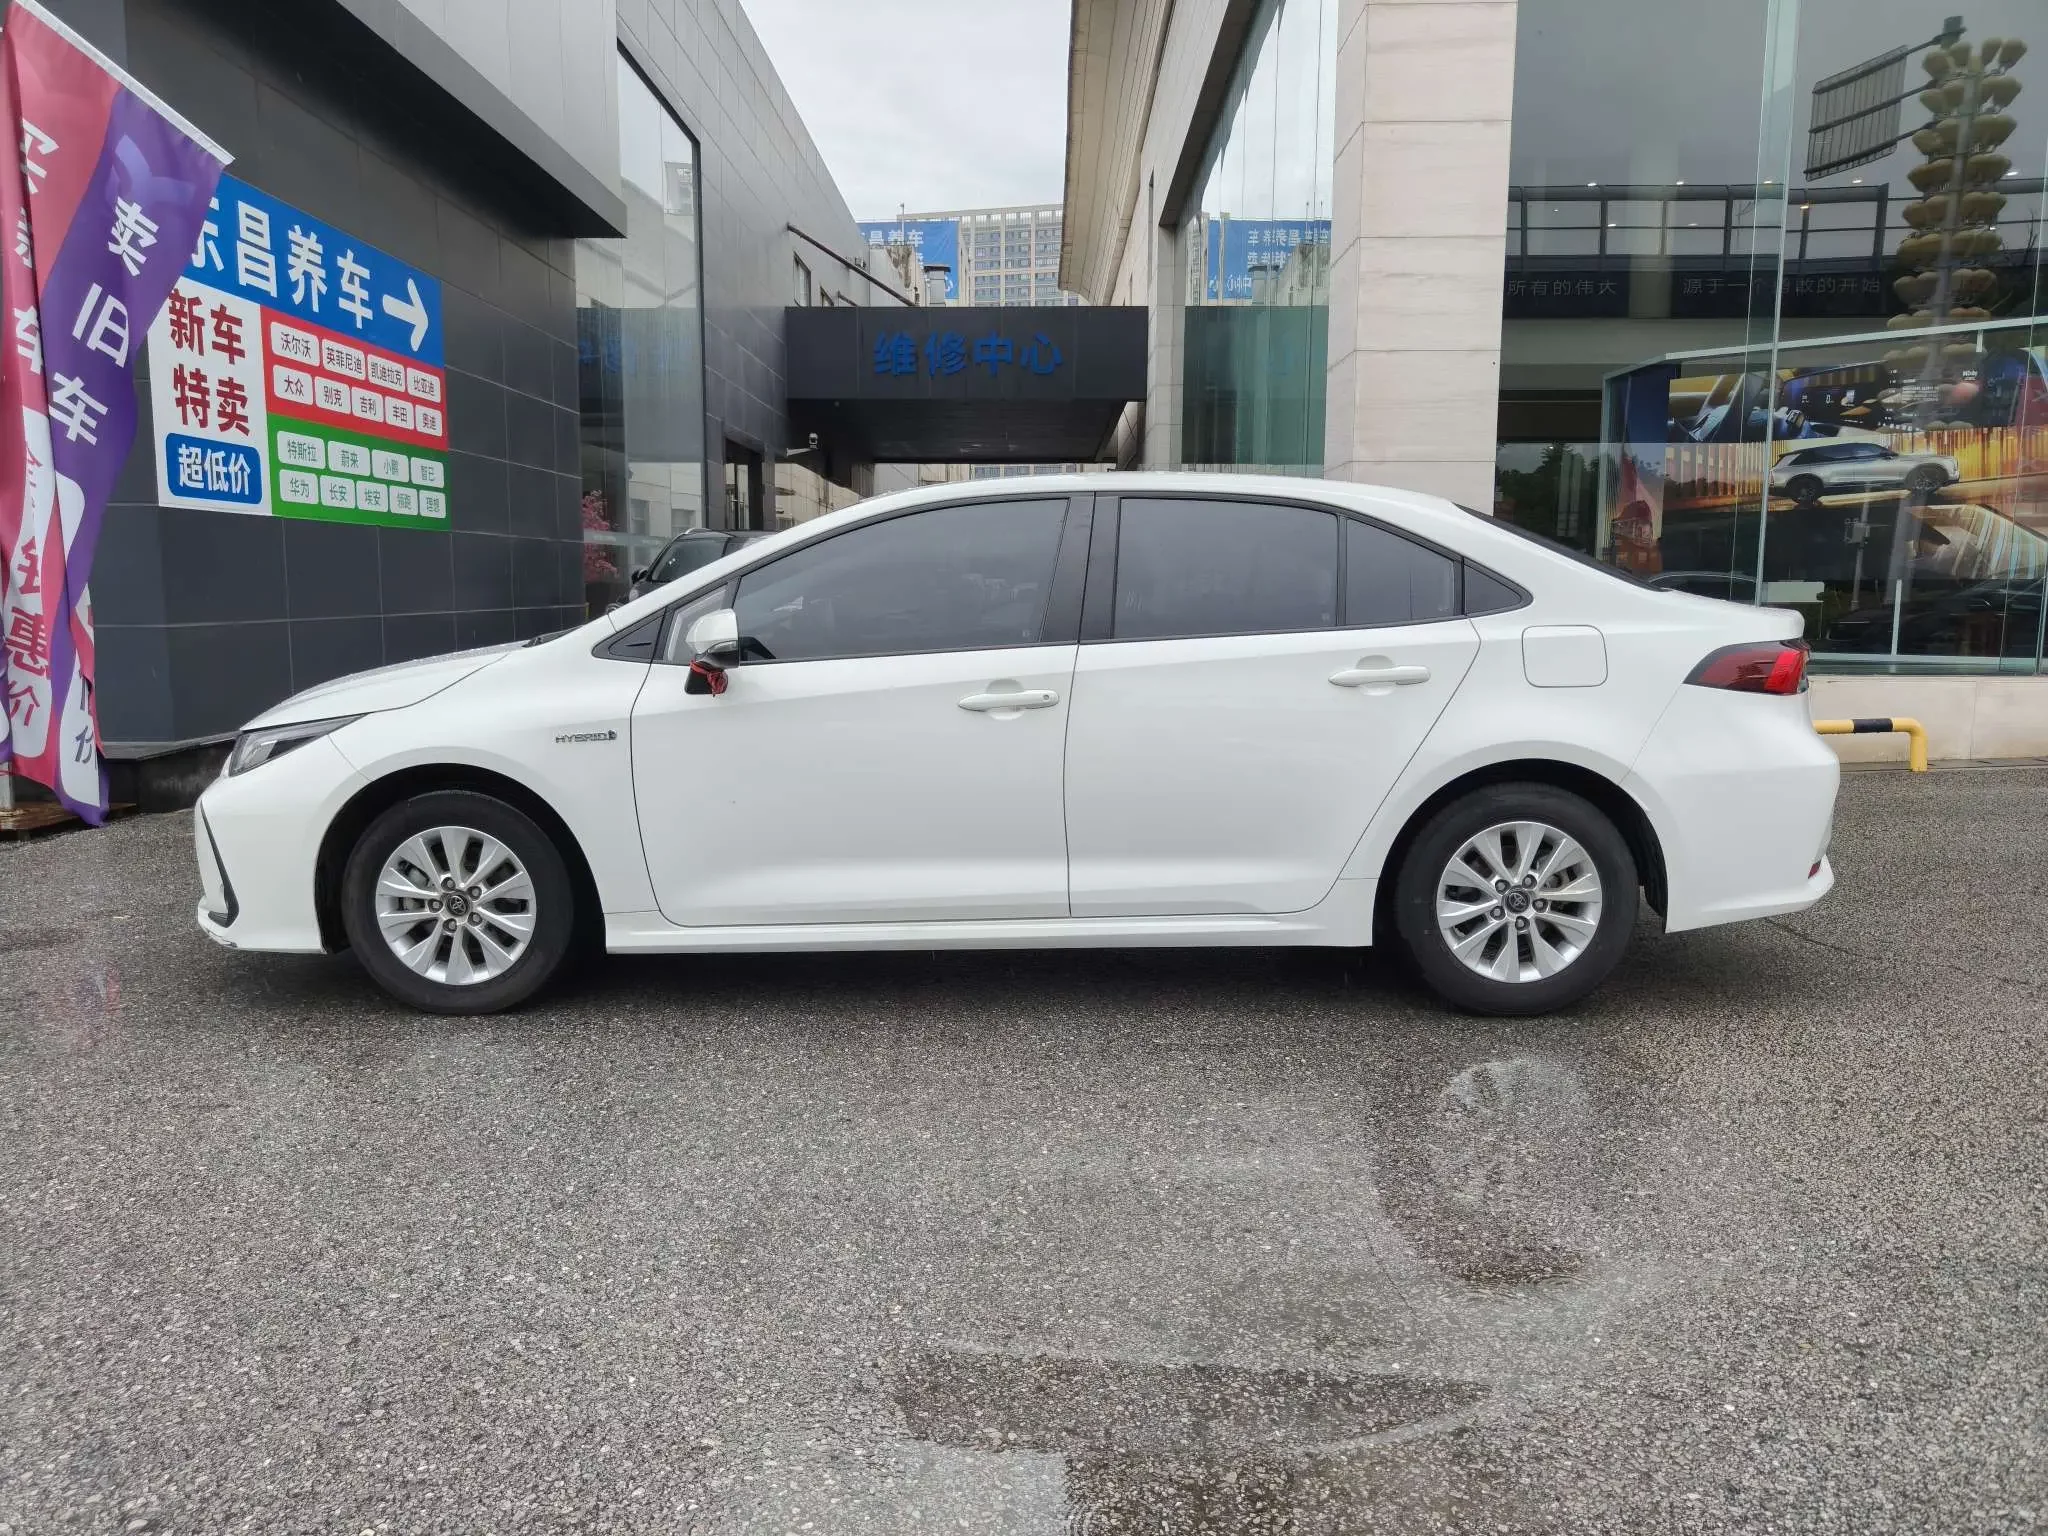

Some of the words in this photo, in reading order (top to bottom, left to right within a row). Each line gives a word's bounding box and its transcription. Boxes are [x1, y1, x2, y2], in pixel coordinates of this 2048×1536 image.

[1507, 279, 1618, 296] 所有的伟大
[49, 196, 159, 445] 卖旧车
[168, 288, 246, 365] 新车
[281, 331, 311, 360] 沃尔沃
[326, 346, 362, 374] 英菲尼迪
[371, 362, 402, 386] 凯迪拉克
[872, 331, 1063, 377] 维修中心
[173, 364, 250, 436] 特卖
[284, 375, 304, 396] 大众
[323, 385, 343, 407] 别克
[360, 396, 377, 416] 吉利
[393, 404, 408, 423] 丰田
[178, 443, 251, 496] 超低价
[287, 440, 317, 462] 特斯拉
[290, 477, 310, 498] 华为
[330, 483, 347, 502] 长安
[555, 732, 607, 743] HYBRID
